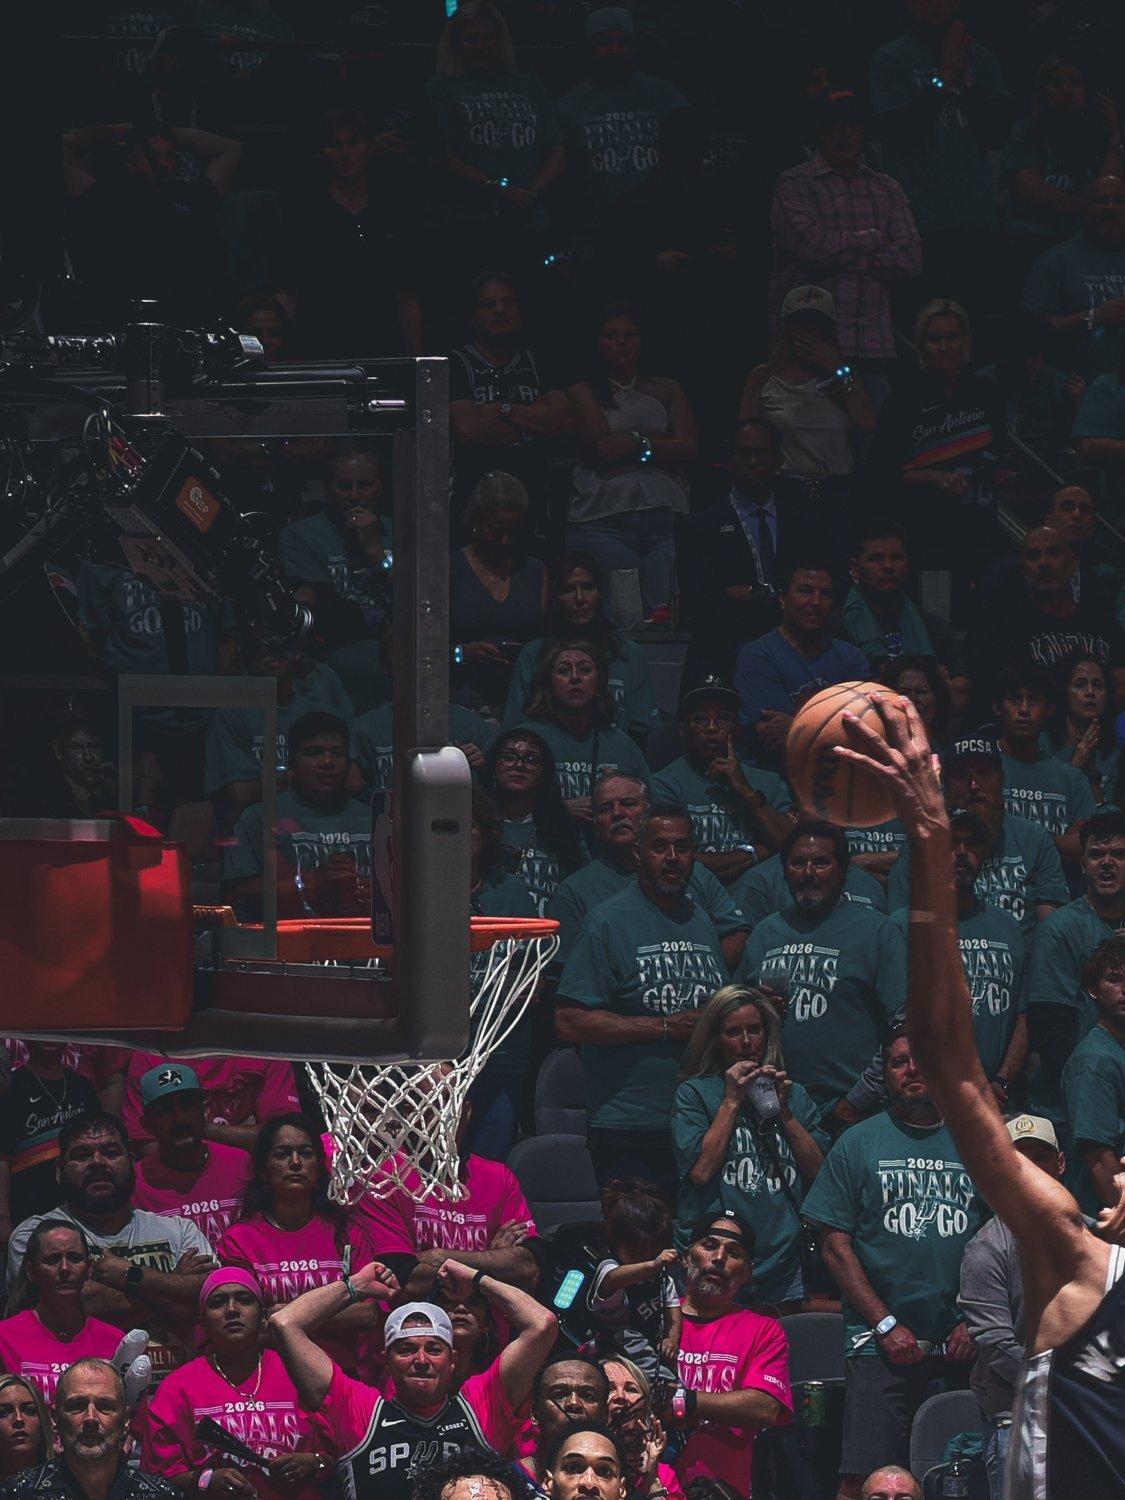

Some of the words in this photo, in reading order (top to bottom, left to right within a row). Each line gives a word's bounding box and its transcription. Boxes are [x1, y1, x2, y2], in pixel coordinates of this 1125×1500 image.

[943, 407, 985, 431] Antonio
[955, 739, 993, 755] TPCSA
[565, 761, 593, 773] 2026
[1011, 788, 1043, 801] 2026
[1004, 801, 1068, 834] INALS
[320, 833, 350, 845] 2026
[866, 832, 894, 842] 2026
[661, 941, 693, 953] 2026
[783, 943, 814, 955] 2026
[959, 938, 989, 950] 2026
[638, 954, 722, 990] FINALS
[961, 950, 1014, 984] NALS
[643, 983, 675, 1015] GO
[795, 987, 829, 1022] GO
[988, 982, 1010, 1017] GO
[907, 1157, 944, 1170] 2026
[880, 1168, 976, 1212] FINALS
[182, 1199, 220, 1216] 2026
[438, 1208, 466, 1225] 2026
[884, 1202, 919, 1240] GO
[936, 1202, 968, 1237] GO
[415, 1218, 488, 1251] FINALS
[280, 1259, 320, 1272] 2026
[676, 1350, 710, 1364] 2026
[224, 1401, 266, 1413] 2026
